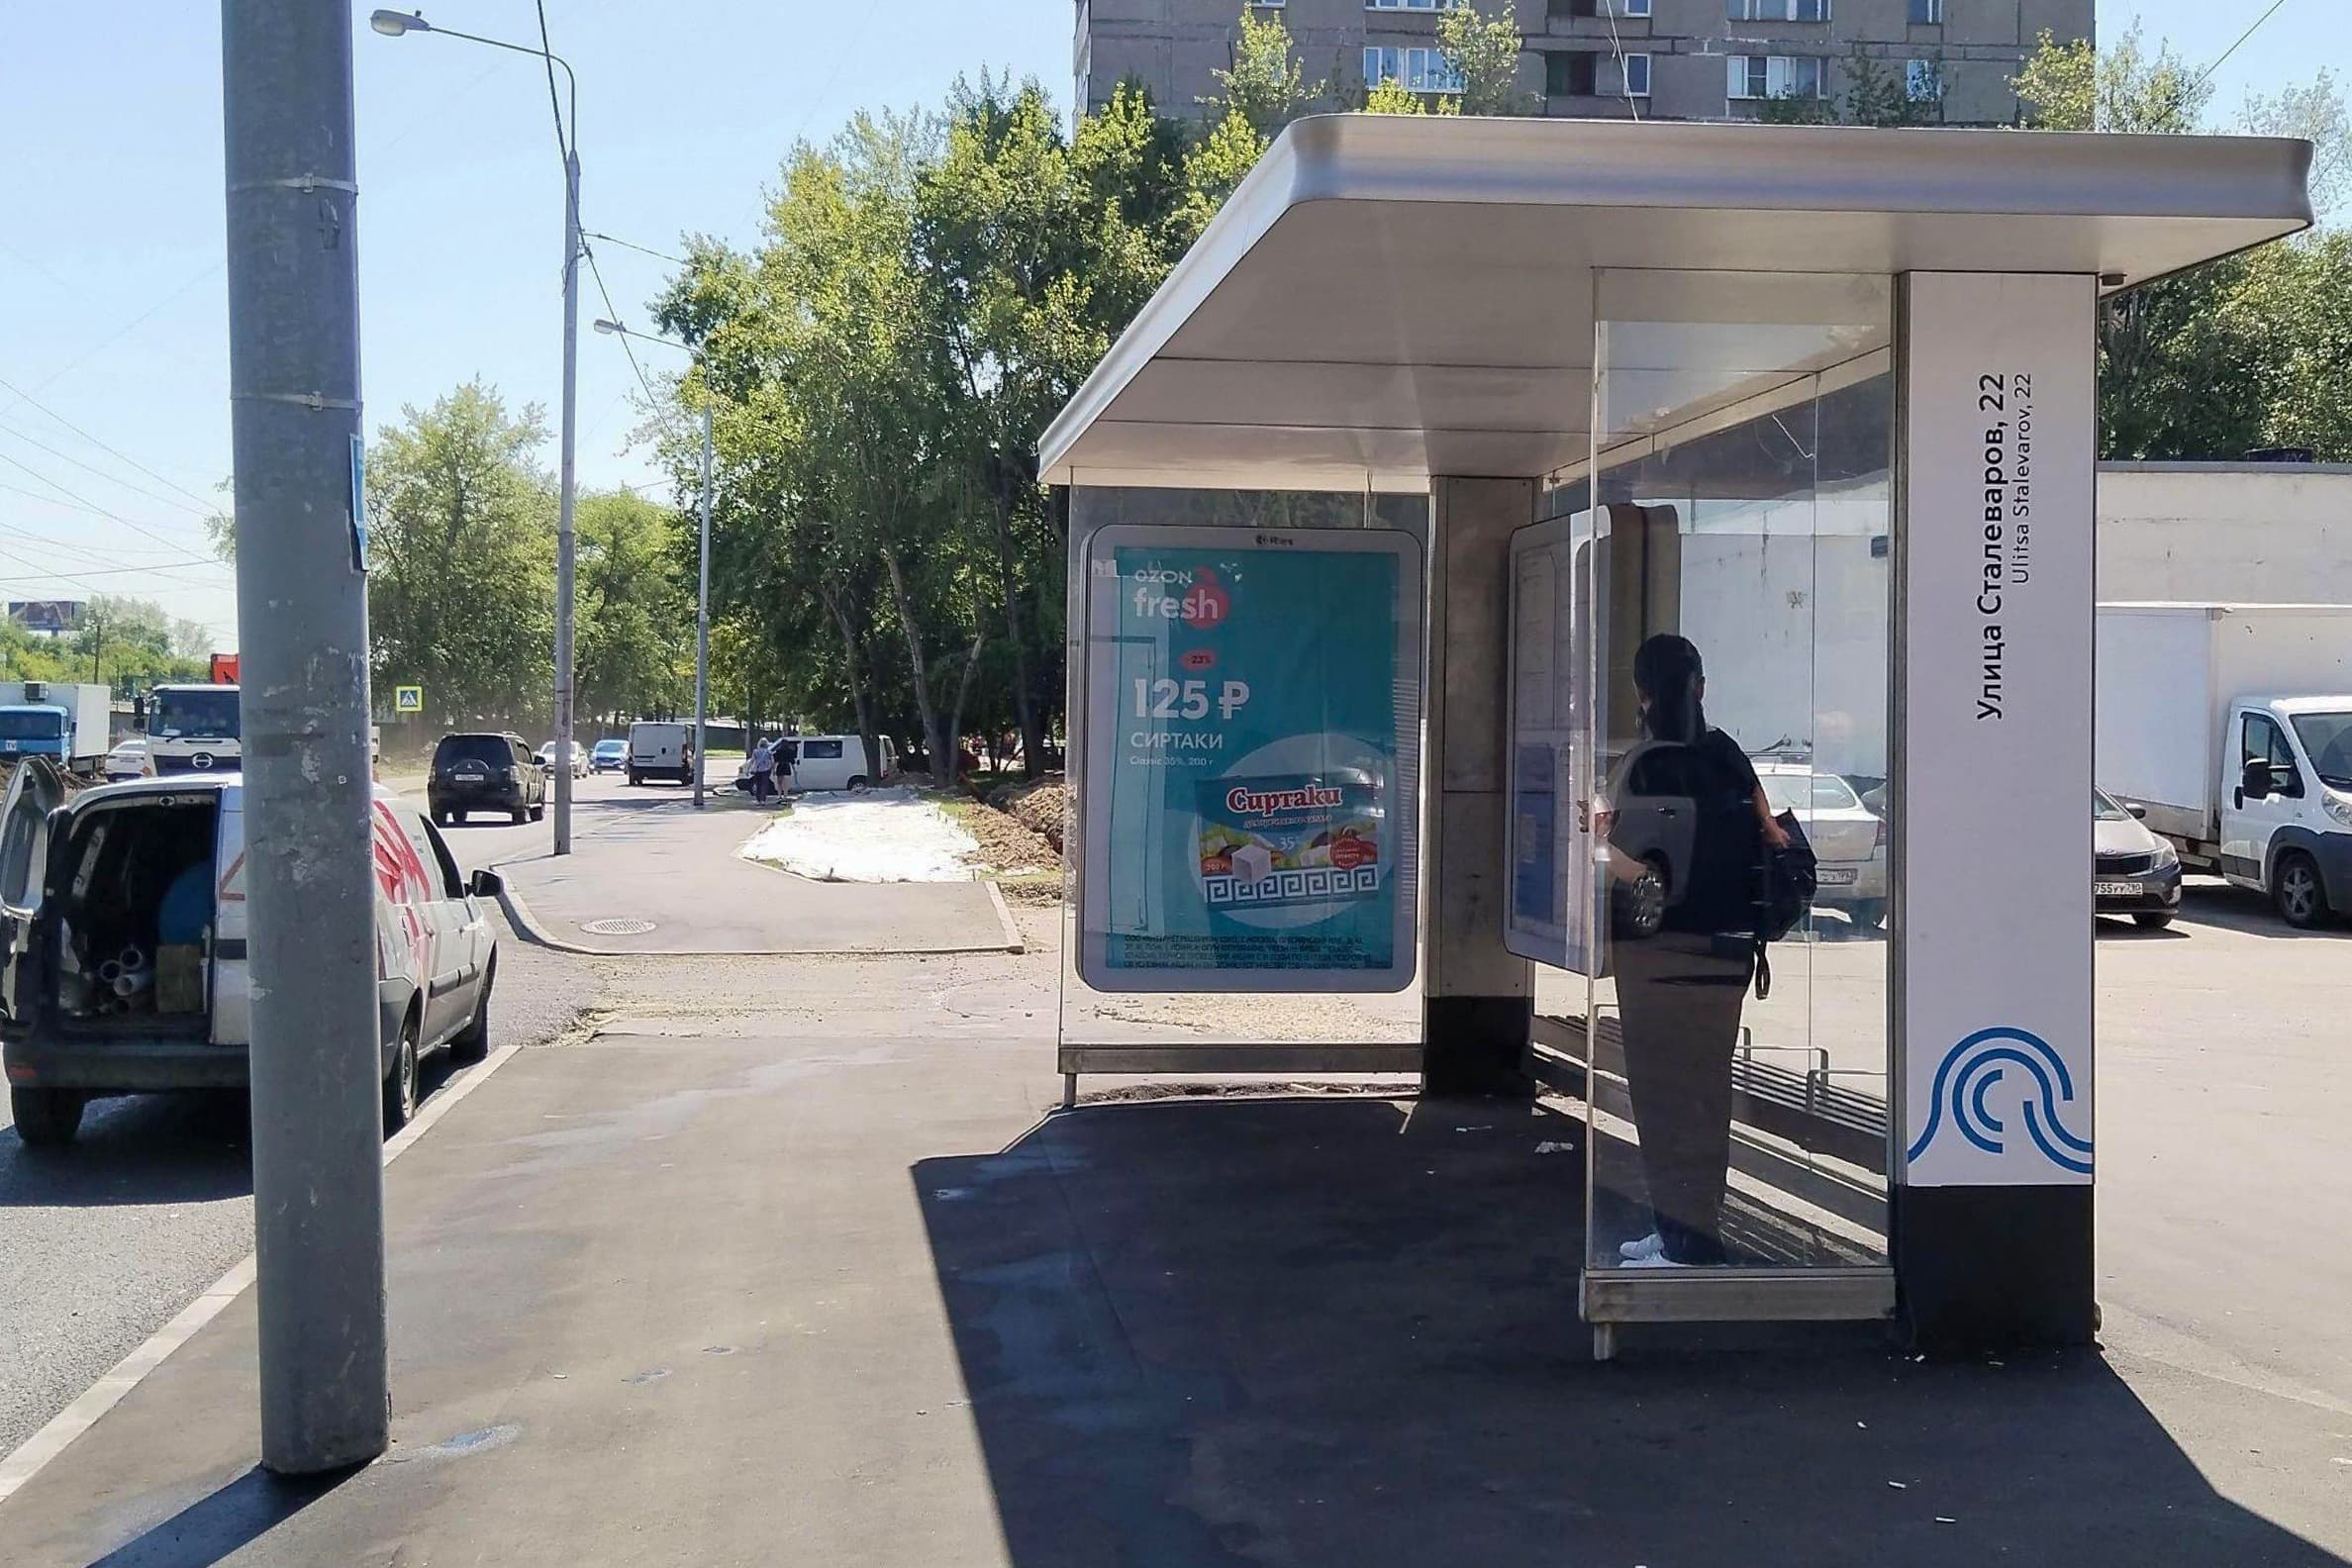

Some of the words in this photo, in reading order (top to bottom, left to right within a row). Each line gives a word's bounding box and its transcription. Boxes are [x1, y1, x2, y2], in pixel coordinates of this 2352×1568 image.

[1979, 373, 2005, 412] 22
[2014, 373, 2031, 398] 22
[2012, 405, 2033, 517] Stalevarov,
[1977, 421, 2009, 615] Сталеваров,
[2011, 524, 2029, 584] Ulitsa
[1133, 586, 1219, 620] fresh
[1977, 624, 2006, 721] Улица
[1134, 678, 1209, 720] 125
[1130, 732, 1223, 749] СИРТАКИ
[1226, 785, 1342, 817] Сиртаки
